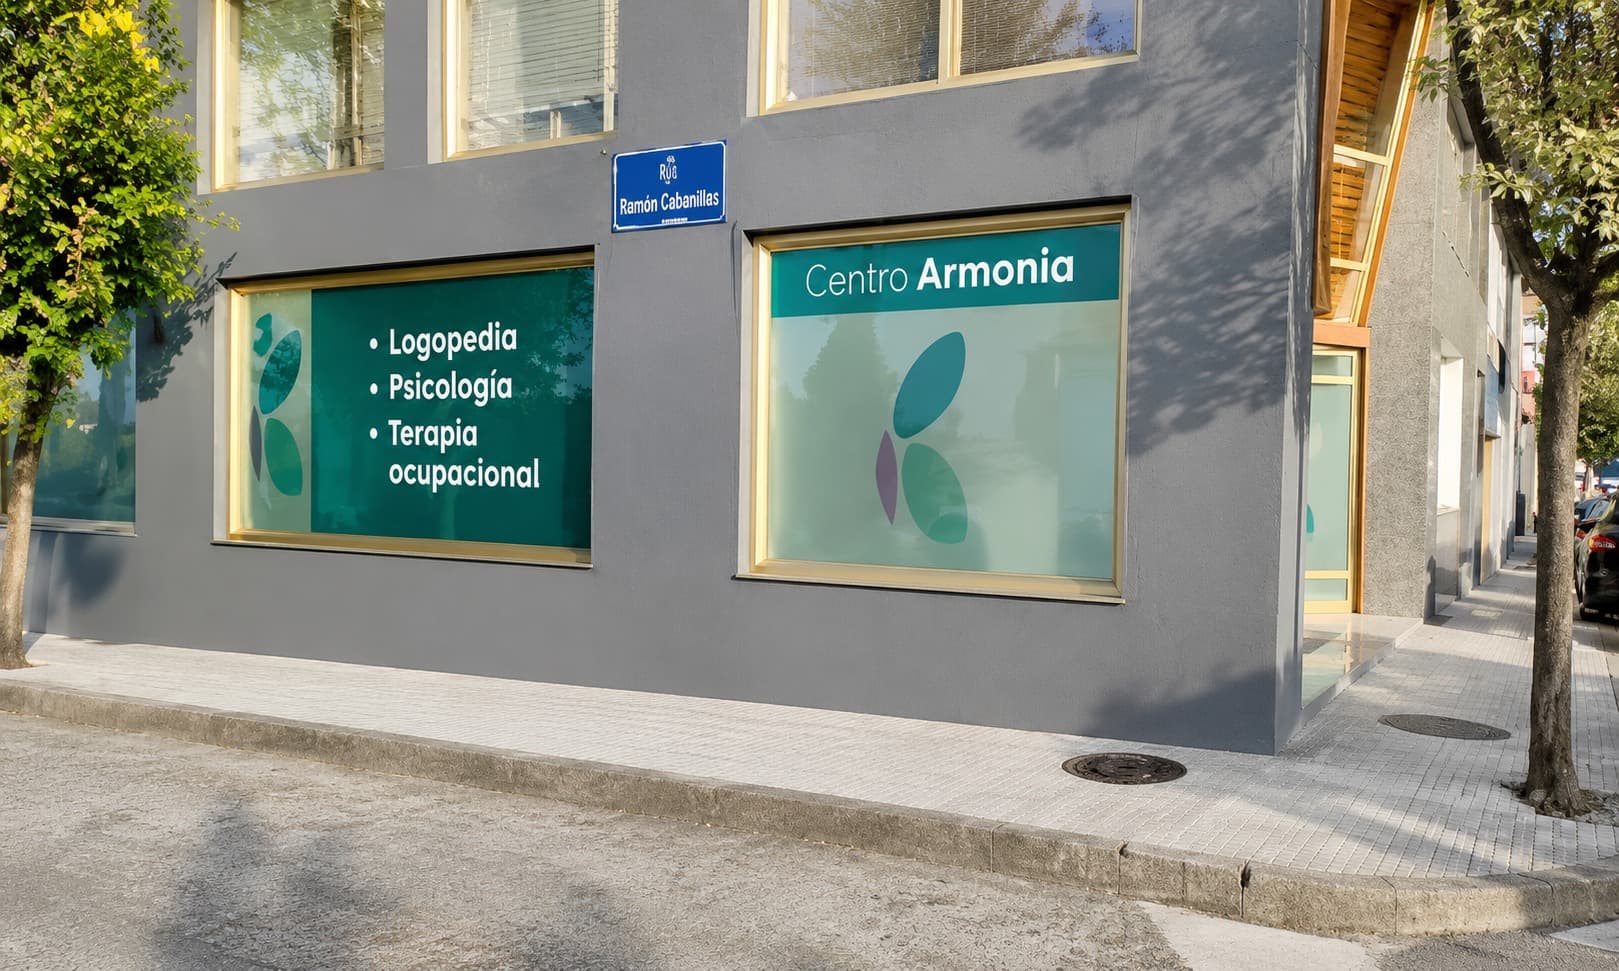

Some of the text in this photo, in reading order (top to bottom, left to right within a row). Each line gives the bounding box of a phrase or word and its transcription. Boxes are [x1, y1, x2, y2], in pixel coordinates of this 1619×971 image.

[620, 189, 719, 215] Ramón Cabanillas
[805, 246, 1075, 297] Centro Armonia
[389, 321, 517, 362] Logopedia
[389, 368, 512, 407] Psicología
[388, 418, 478, 454] Terapia
[389, 458, 540, 493] ocupacional
